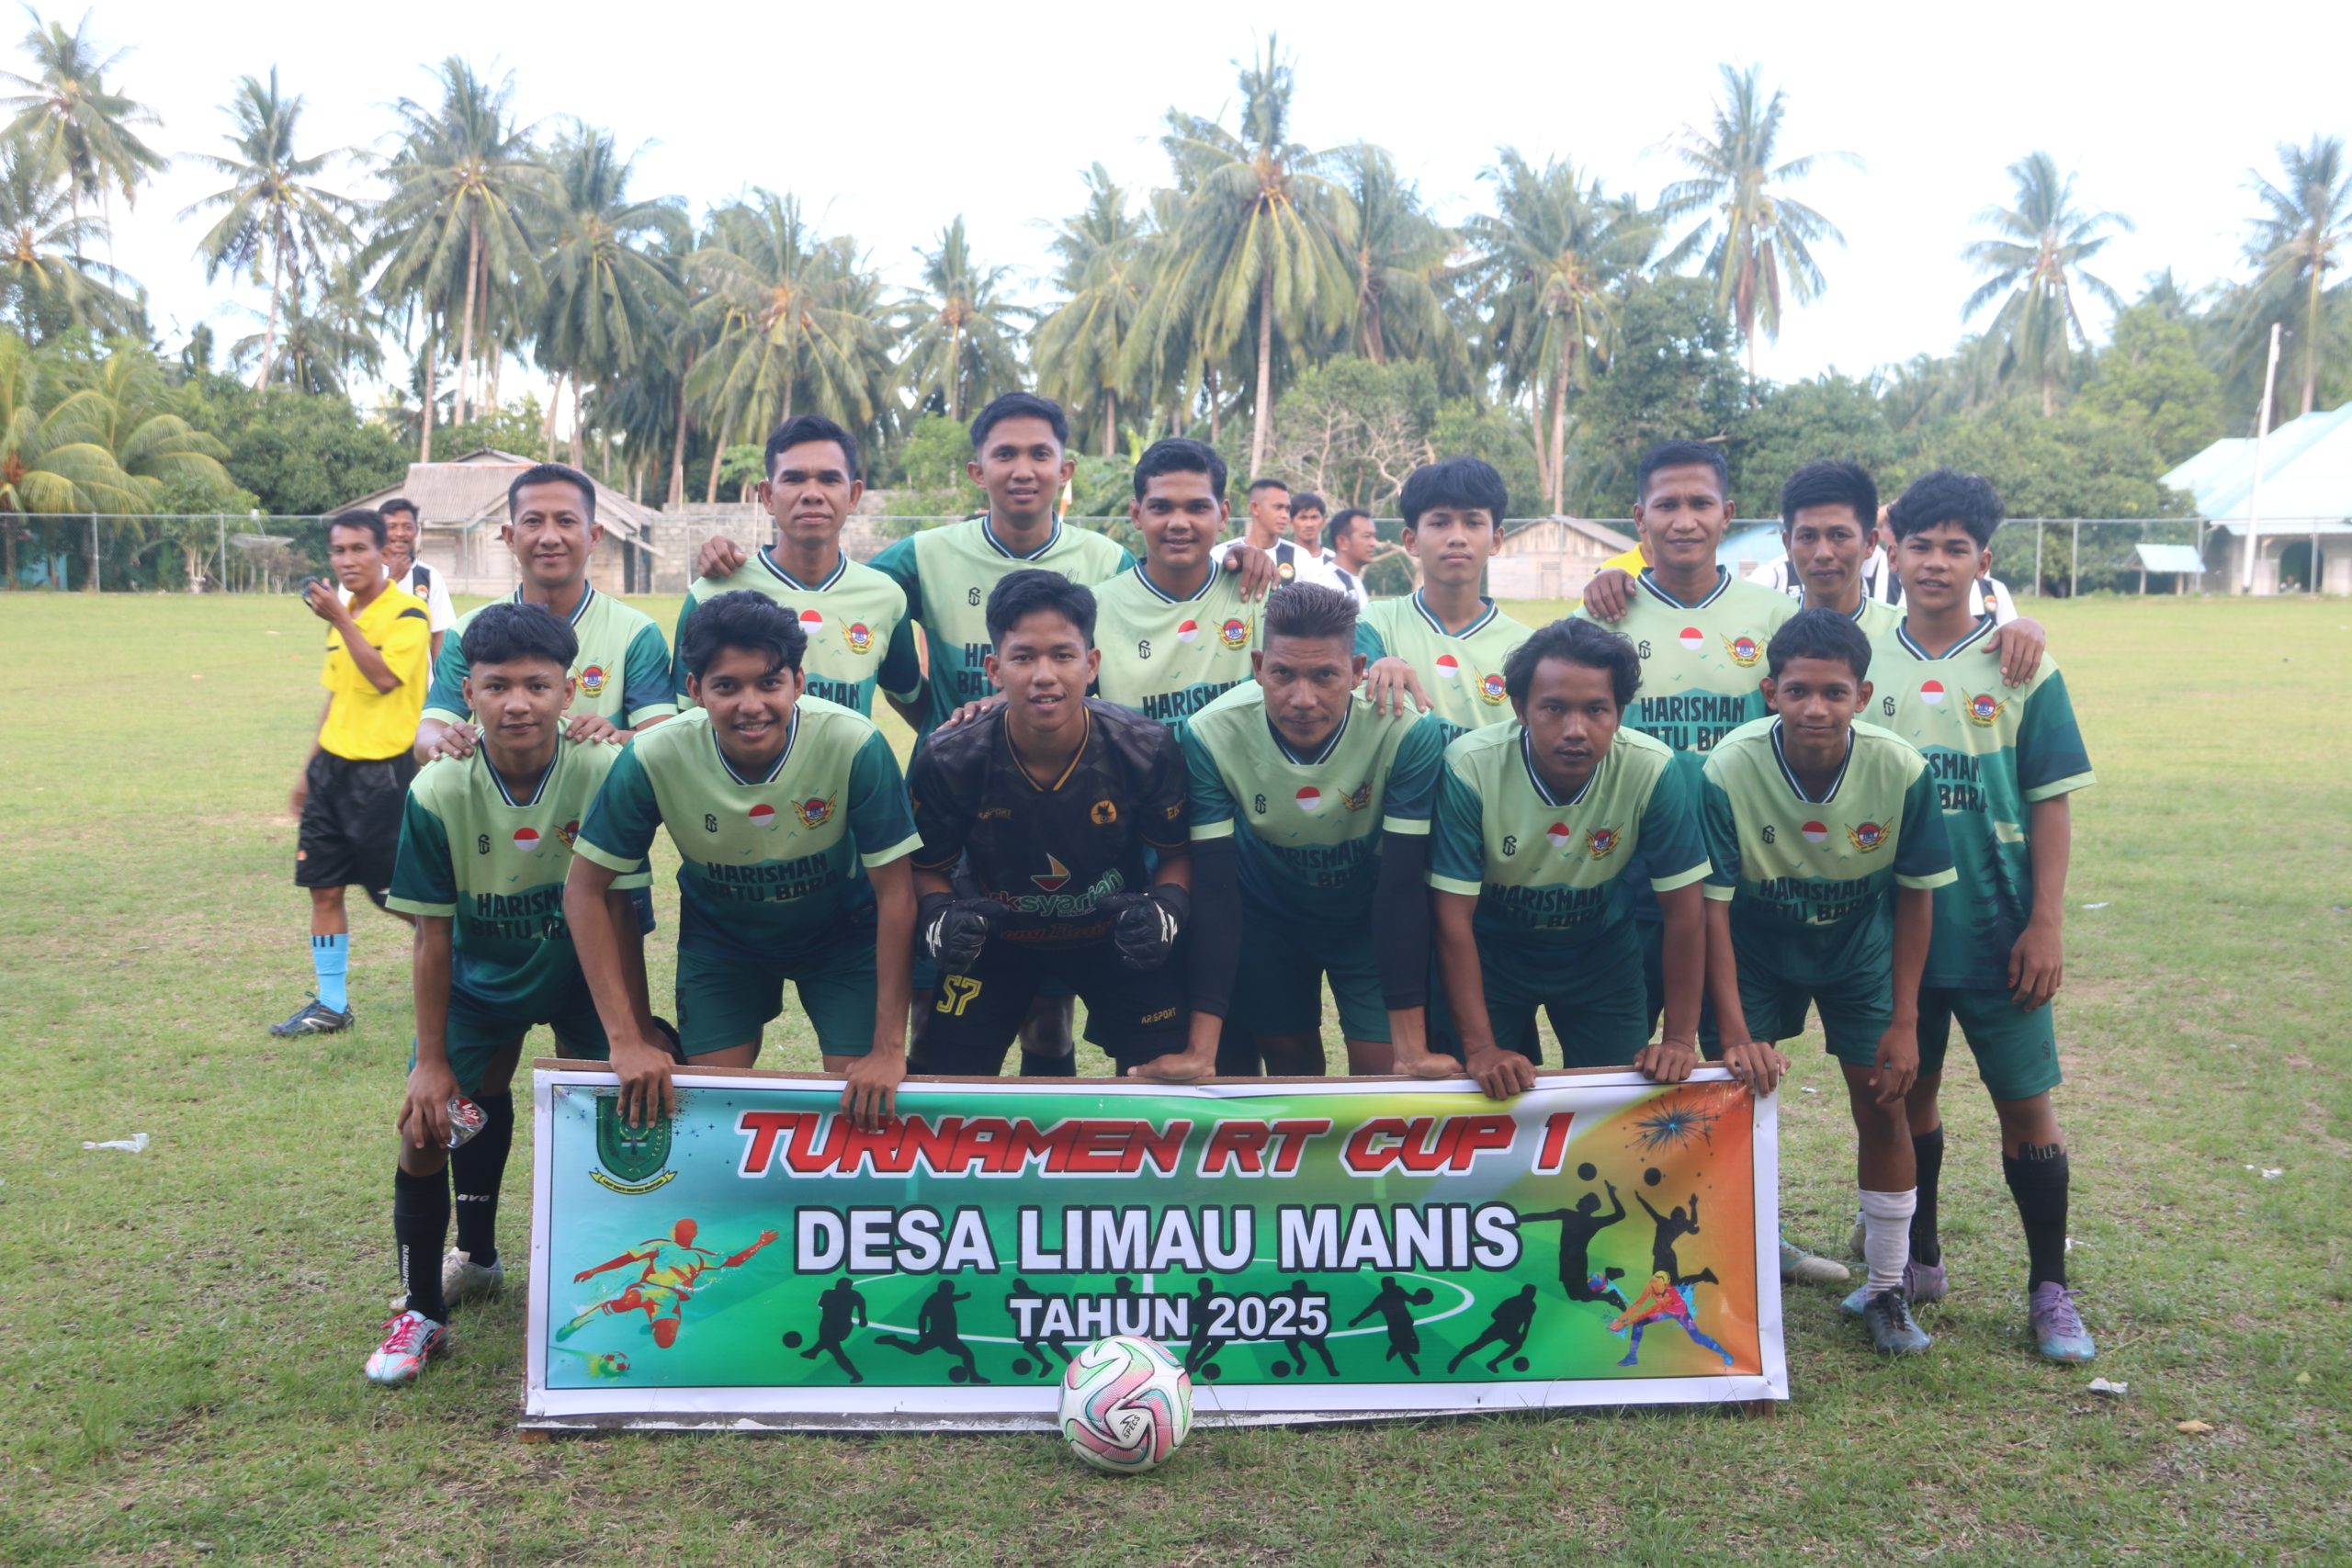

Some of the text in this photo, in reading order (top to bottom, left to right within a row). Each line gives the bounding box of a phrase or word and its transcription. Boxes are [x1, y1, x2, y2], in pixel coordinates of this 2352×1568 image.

[807, 681, 861, 710] SMAN
[1142, 682, 1240, 720] HARISM
[1640, 696, 1745, 722] HARISMAN
[1634, 726, 1689, 750] ATU
[1925, 752, 1982, 783] SMAN
[707, 852, 829, 885] HARISMAN
[477, 886, 563, 918] HARISM
[702, 877, 765, 902] BATU
[1491, 883, 1603, 912] HARISMAN
[1758, 875, 1871, 901] HARISMAN
[470, 917, 532, 941] BATU
[741, 1111, 1575, 1176] TURNAMEN RT CUP 1
[796, 1207, 1521, 1273] DESA LIMAU MANIS
[1009, 1294, 1329, 1339] TAHUN 2025
[1124, 1416, 1140, 1438] SPECS
